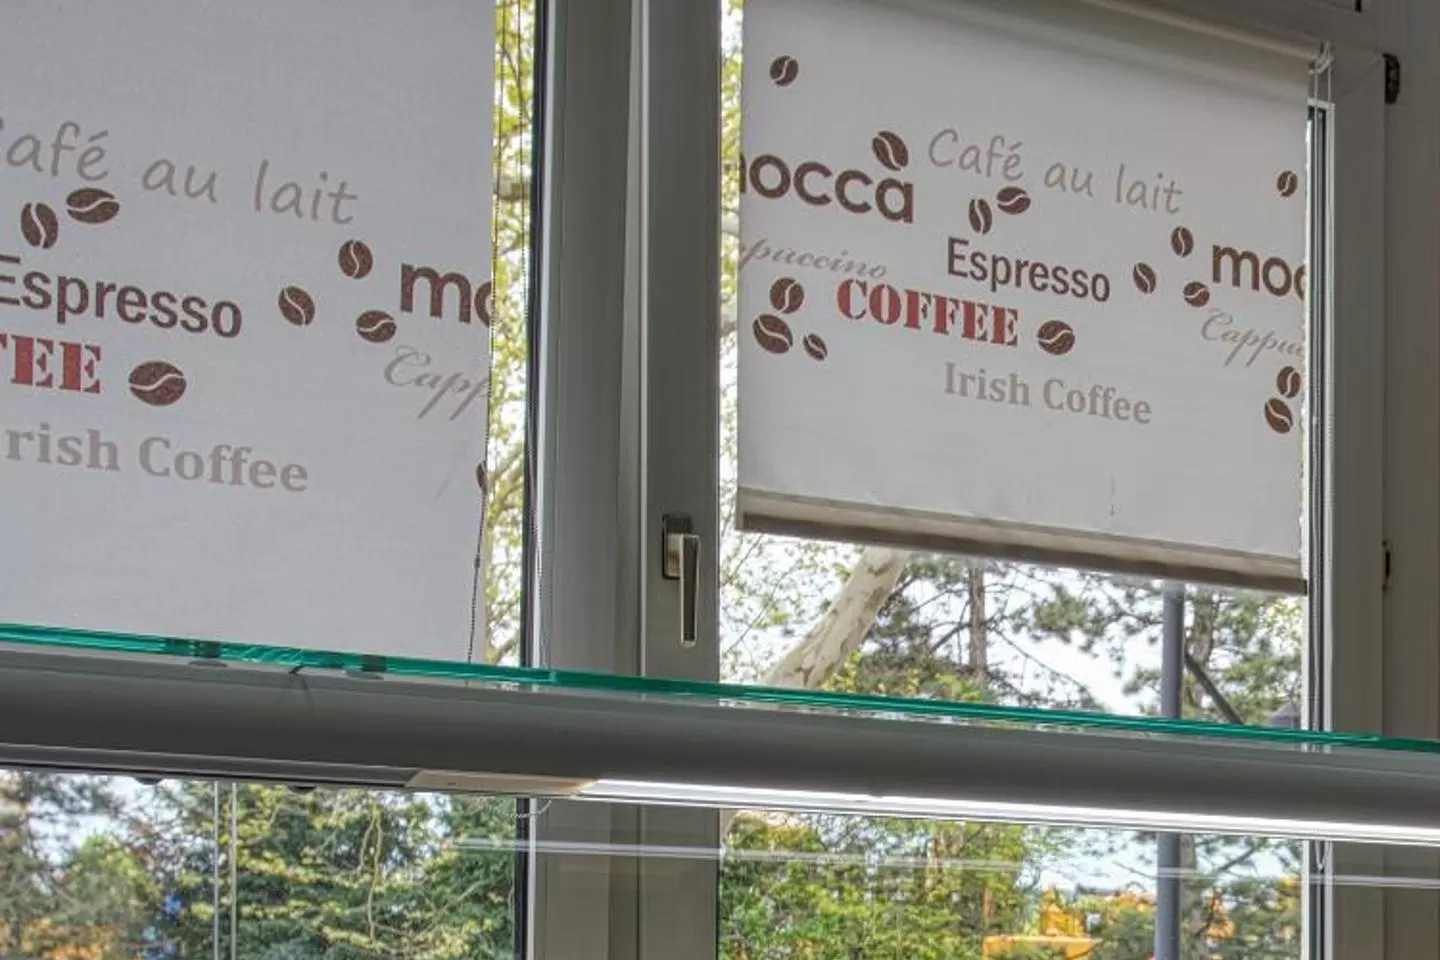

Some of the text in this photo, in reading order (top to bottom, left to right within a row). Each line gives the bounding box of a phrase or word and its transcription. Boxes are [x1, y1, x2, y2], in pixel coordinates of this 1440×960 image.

[0, 117, 359, 225] afé au lait
[739, 152, 914, 224] occa
[928, 127, 1184, 215] Café au lait
[739, 237, 888, 279] puccino
[946, 236, 1111, 303] Espresso
[836, 277, 1019, 349] COFFEE
[943, 360, 1152, 425] Irish Coffee
[138, 435, 309, 493] Coffee
